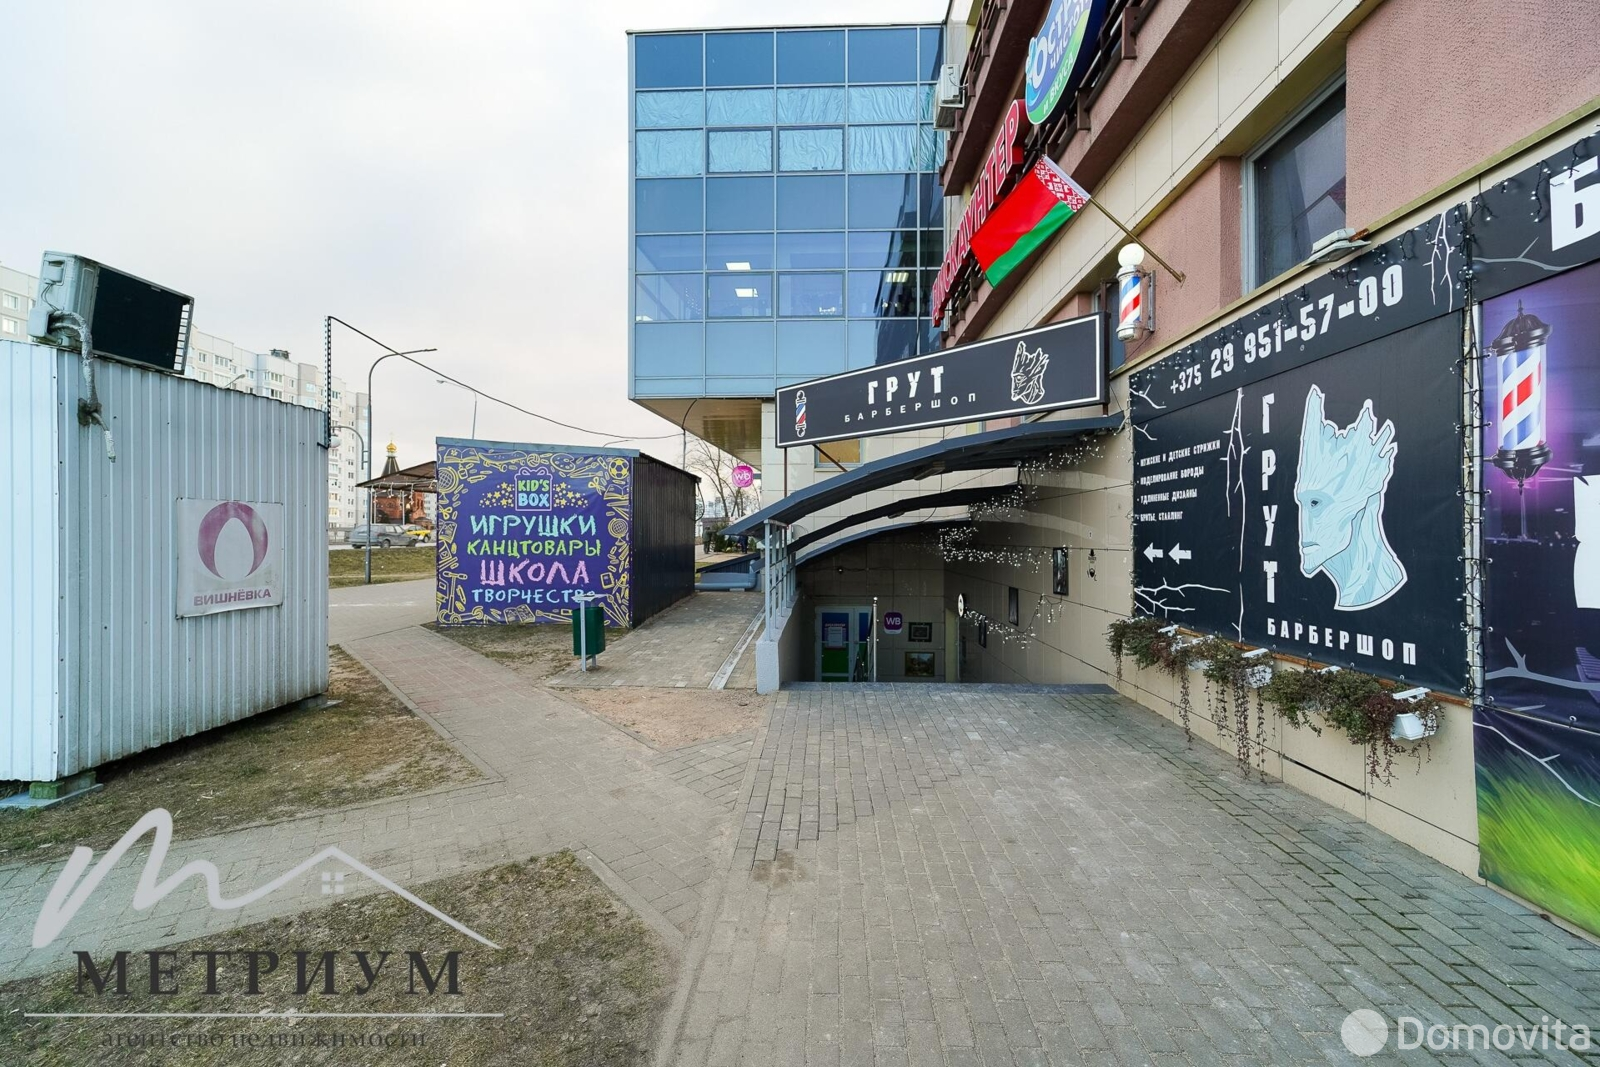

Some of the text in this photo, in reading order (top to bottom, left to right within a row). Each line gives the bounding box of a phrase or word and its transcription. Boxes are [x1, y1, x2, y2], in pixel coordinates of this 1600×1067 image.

[1032, 0, 1078, 89] ОСТР
[1050, 0, 1089, 69] ЧИСТОТ
[1050, 52, 1074, 101] ВКУСА
[1170, 264, 1403, 395] +375 29 951-57-00
[867, 365, 944, 405] ГРУТ
[844, 392, 976, 423] БАРБЕРШОП
[1162, 453, 1166, 462] И
[1168, 447, 1191, 462] ДЕТСКИЕ
[1193, 440, 1220, 454] СТРИЖКИ
[517, 479, 550, 491] KID'S
[1140, 465, 1205, 486] МОДЕЛИРОВАНИЕ БОРОДЫ
[517, 493, 550, 507] BOX
[1171, 488, 1197, 502] ДИЗАЙНЫ
[1261, 392, 1278, 604] ГРУТ
[470, 514, 597, 537] ИГРУШКИ
[467, 539, 601, 558] КАНЦТОВАРЫ
[480, 558, 590, 585] ШКОЛА
[193, 588, 272, 607] ВИШНЁВКА
[886, 617, 901, 625] WB
[1267, 617, 1417, 666] БАРБЕРШОП
